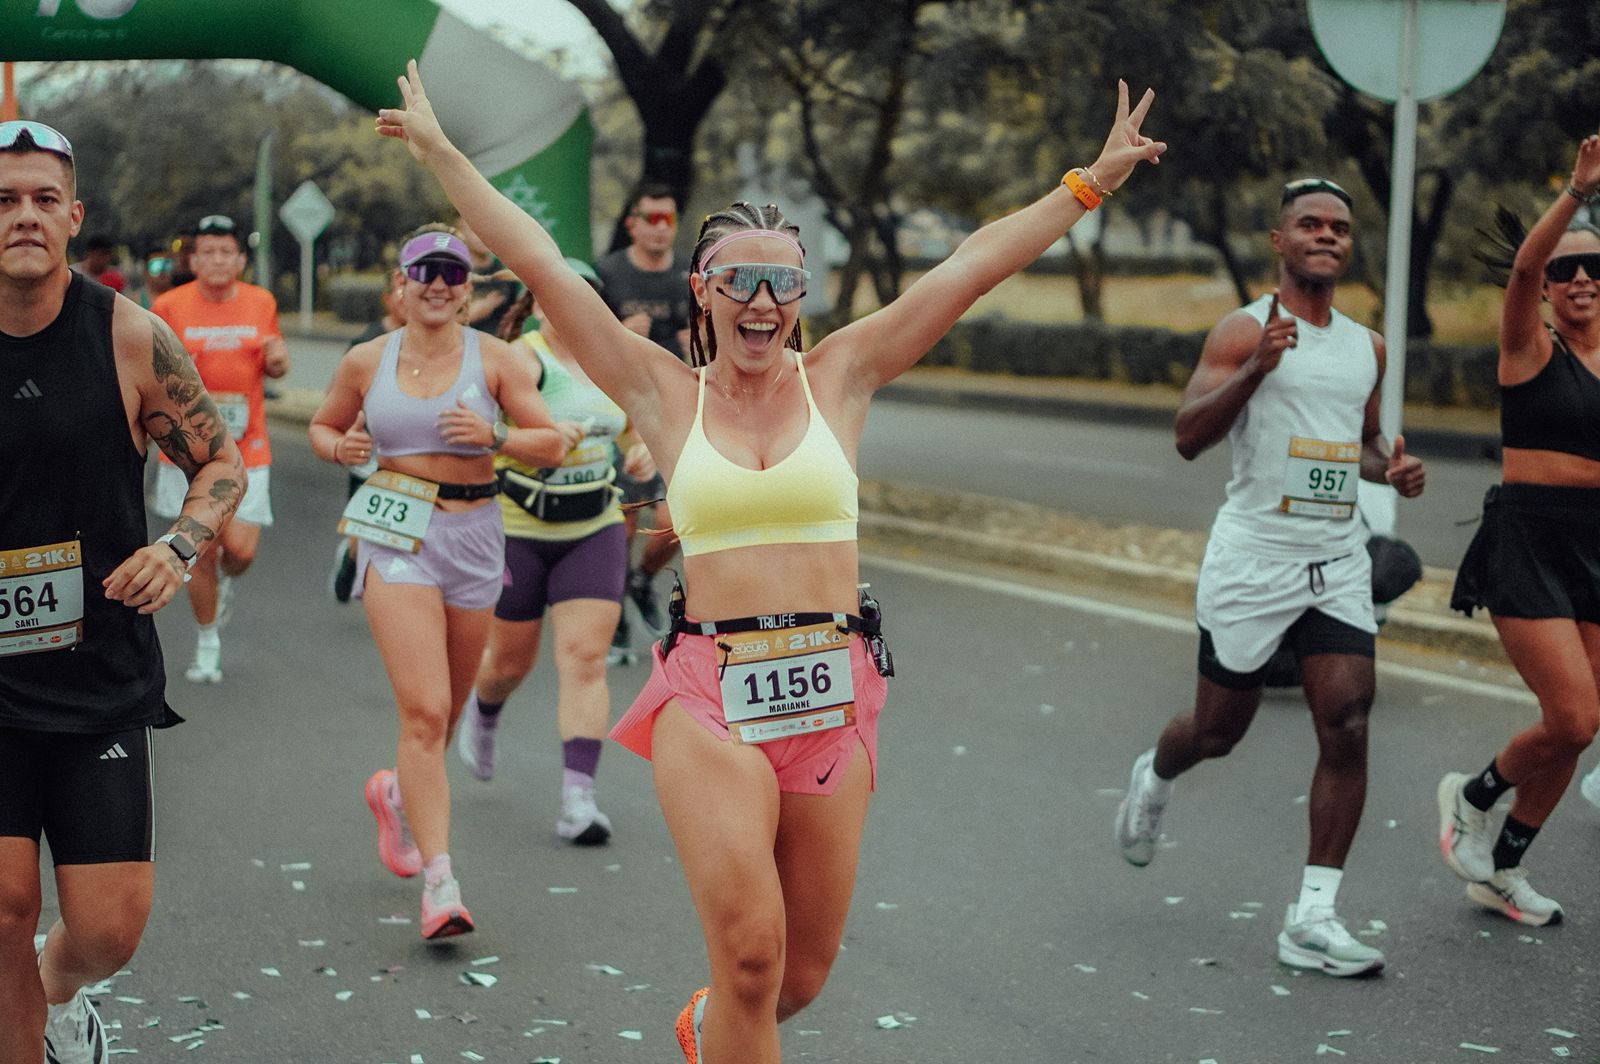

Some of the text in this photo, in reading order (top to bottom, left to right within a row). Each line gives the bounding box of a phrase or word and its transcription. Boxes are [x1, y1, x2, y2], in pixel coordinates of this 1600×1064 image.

[1308, 467, 1347, 492] 957
[366, 494, 408, 522] 973
[25, 549, 65, 568] 21K
[0, 582, 58, 619] 564
[15, 618, 39, 629] SANTI
[757, 613, 796, 630] TRILIFE
[788, 630, 831, 650] 21K
[744, 662, 832, 705] 1156
[769, 700, 811, 714] MARIANNE
